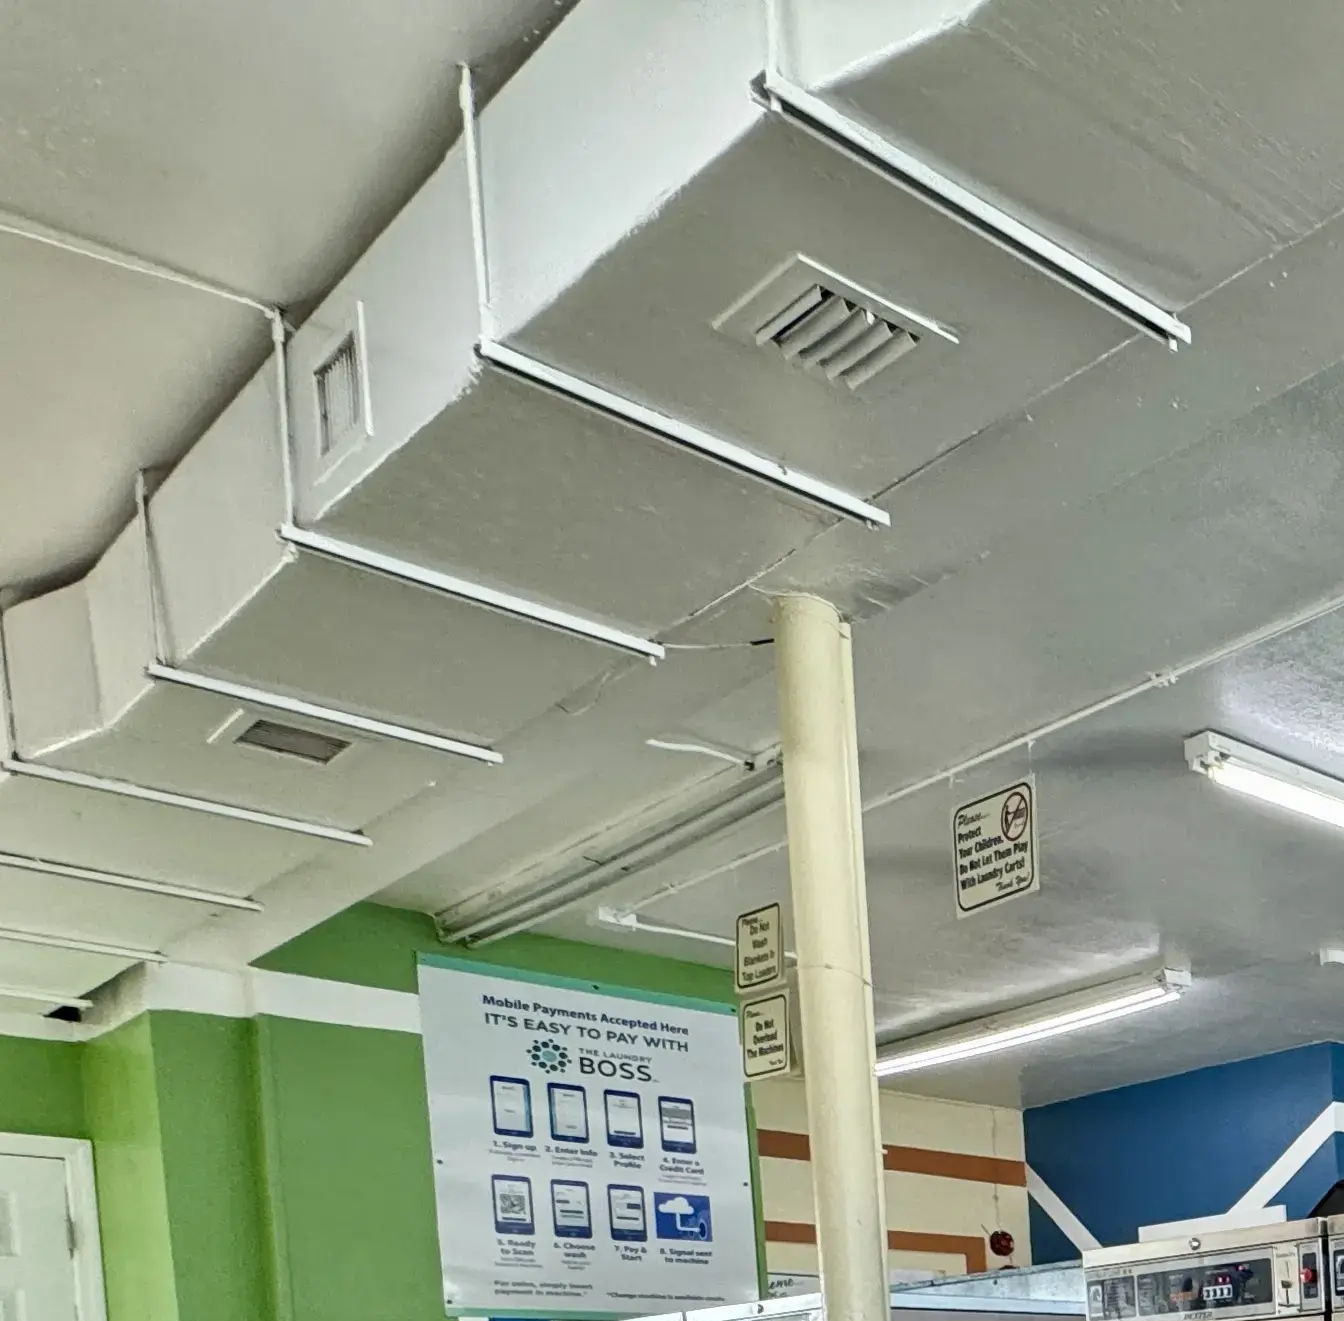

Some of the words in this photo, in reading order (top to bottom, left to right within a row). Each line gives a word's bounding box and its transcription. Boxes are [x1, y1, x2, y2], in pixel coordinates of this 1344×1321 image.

[958, 826, 982, 844] Protect
[959, 846, 973, 859] Your
[960, 864, 968, 875] Do
[970, 859, 981, 872] Not
[982, 854, 993, 866] Let
[995, 846, 1012, 861] Them
[1014, 841, 1028, 853] Play
[961, 876, 976, 890] With
[977, 867, 1003, 884] Laundry
[483, 994, 530, 1012] Mobile
[533, 1002, 597, 1023] Payments
[600, 1013, 657, 1031] Accepted
[660, 1022, 689, 1036] Here
[485, 1012, 518, 1028] IT'S
[523, 1018, 571, 1036] EASY
[576, 1026, 600, 1040] TO
[607, 1031, 639, 1045] PAY
[643, 1036, 689, 1053] WITH
[579, 1048, 599, 1057] THE
[604, 1051, 652, 1064] LAUNDRY
[579, 1057, 652, 1083] BOSS
[503, 1141, 523, 1151] Sign
[659, 1164, 684, 1173] Credit
[685, 1167, 704, 1175] Card
[507, 1239, 536, 1249] Ready
[564, 1242, 596, 1251] Choose
[621, 1253, 642, 1262] Start
[675, 1257, 709, 1265] machine
